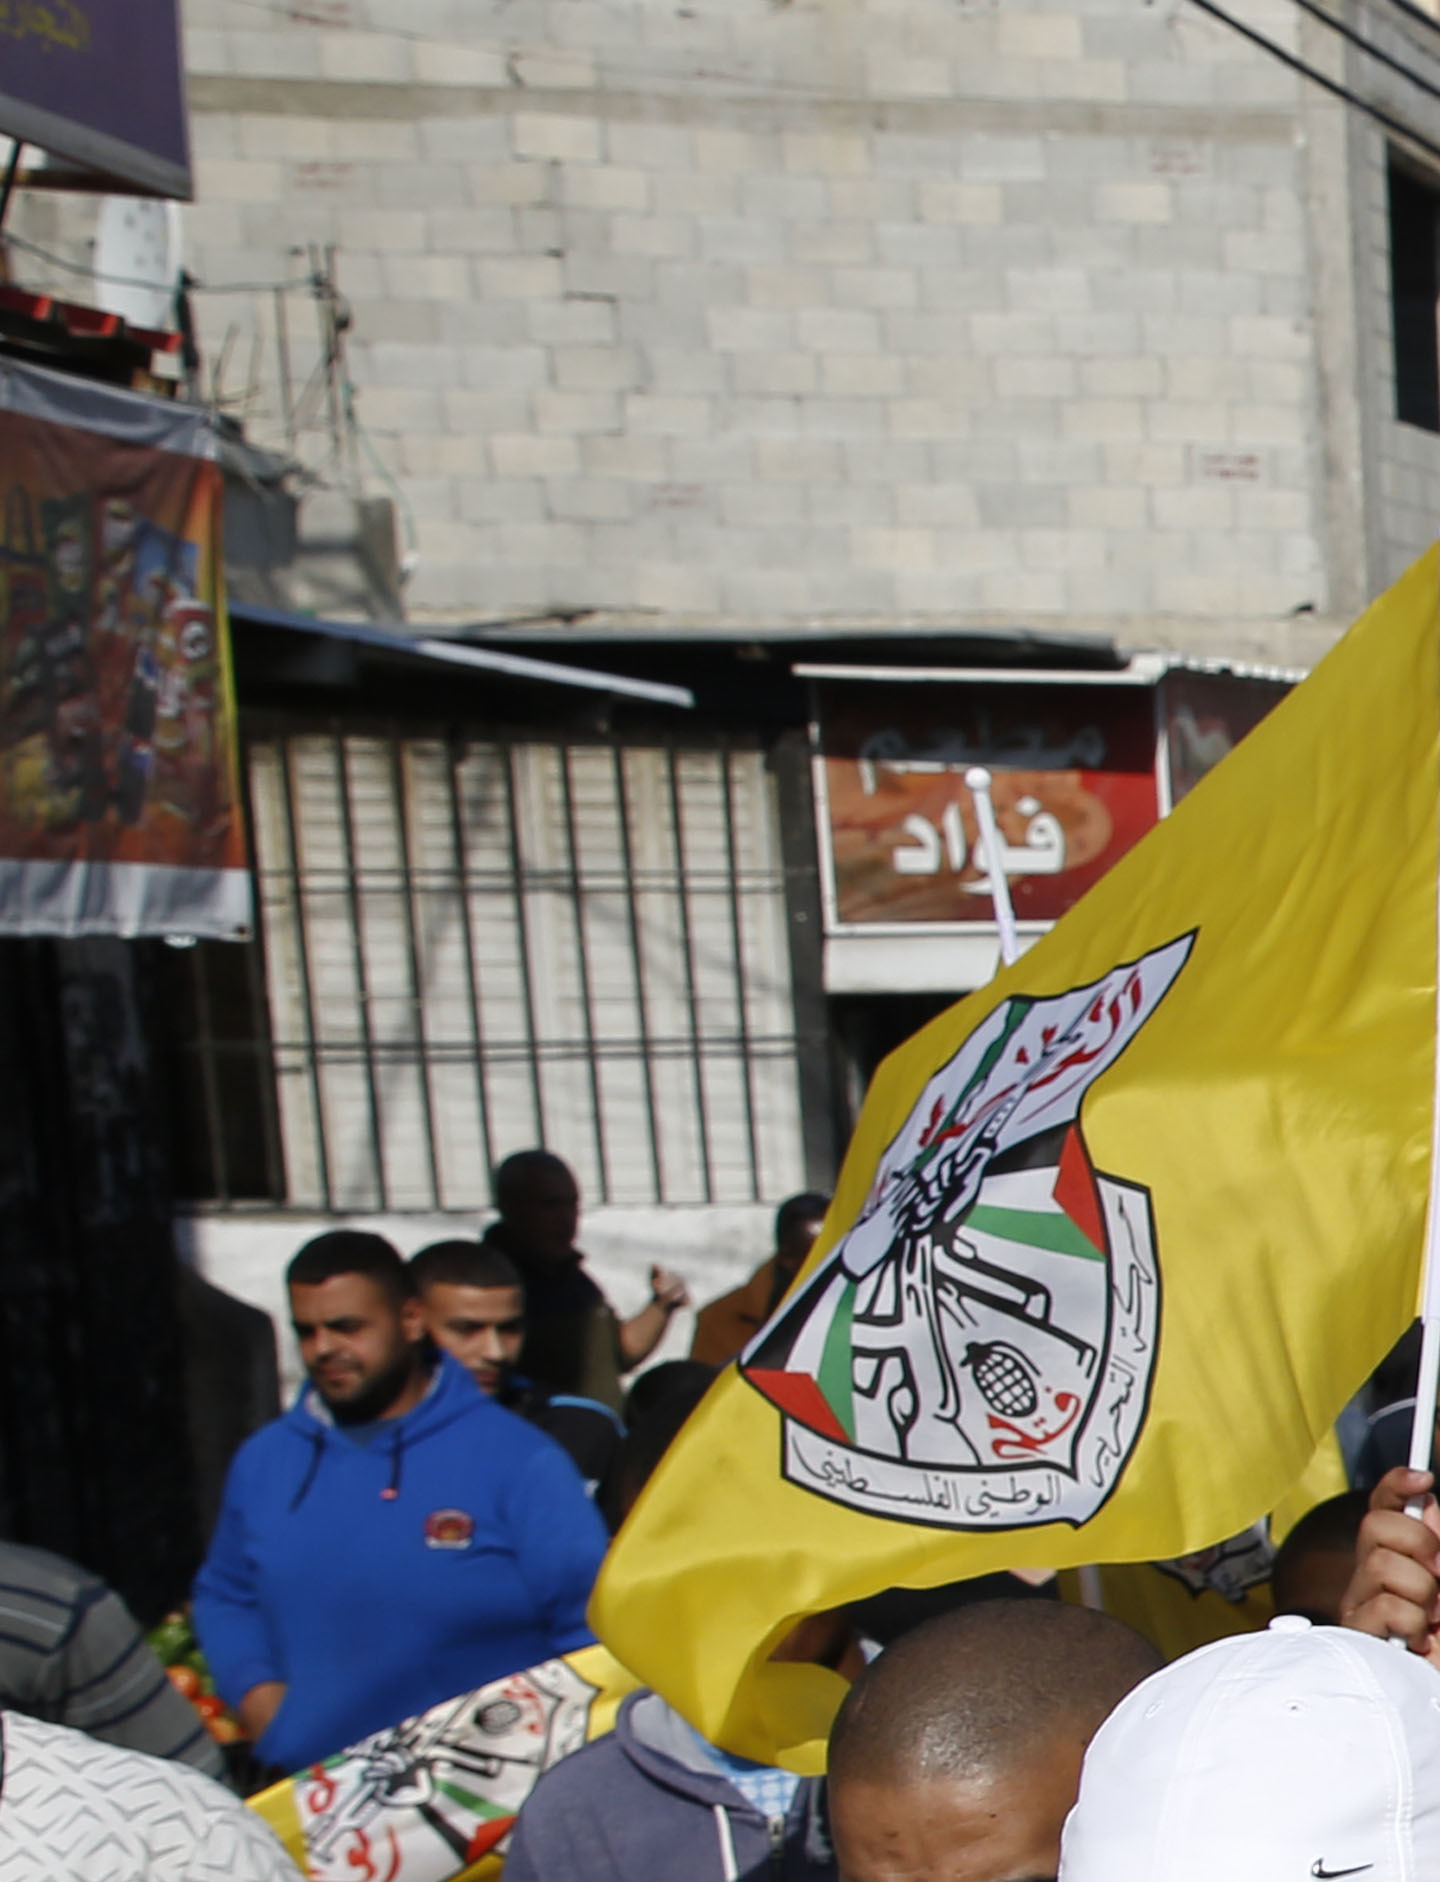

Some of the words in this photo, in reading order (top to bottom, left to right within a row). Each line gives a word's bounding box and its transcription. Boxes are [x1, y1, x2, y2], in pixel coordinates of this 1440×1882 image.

[986, 1386, 1081, 1460] فتح
[791, 1434, 960, 1511] الفلسطيني
[965, 1473, 1062, 1517] الوطني
